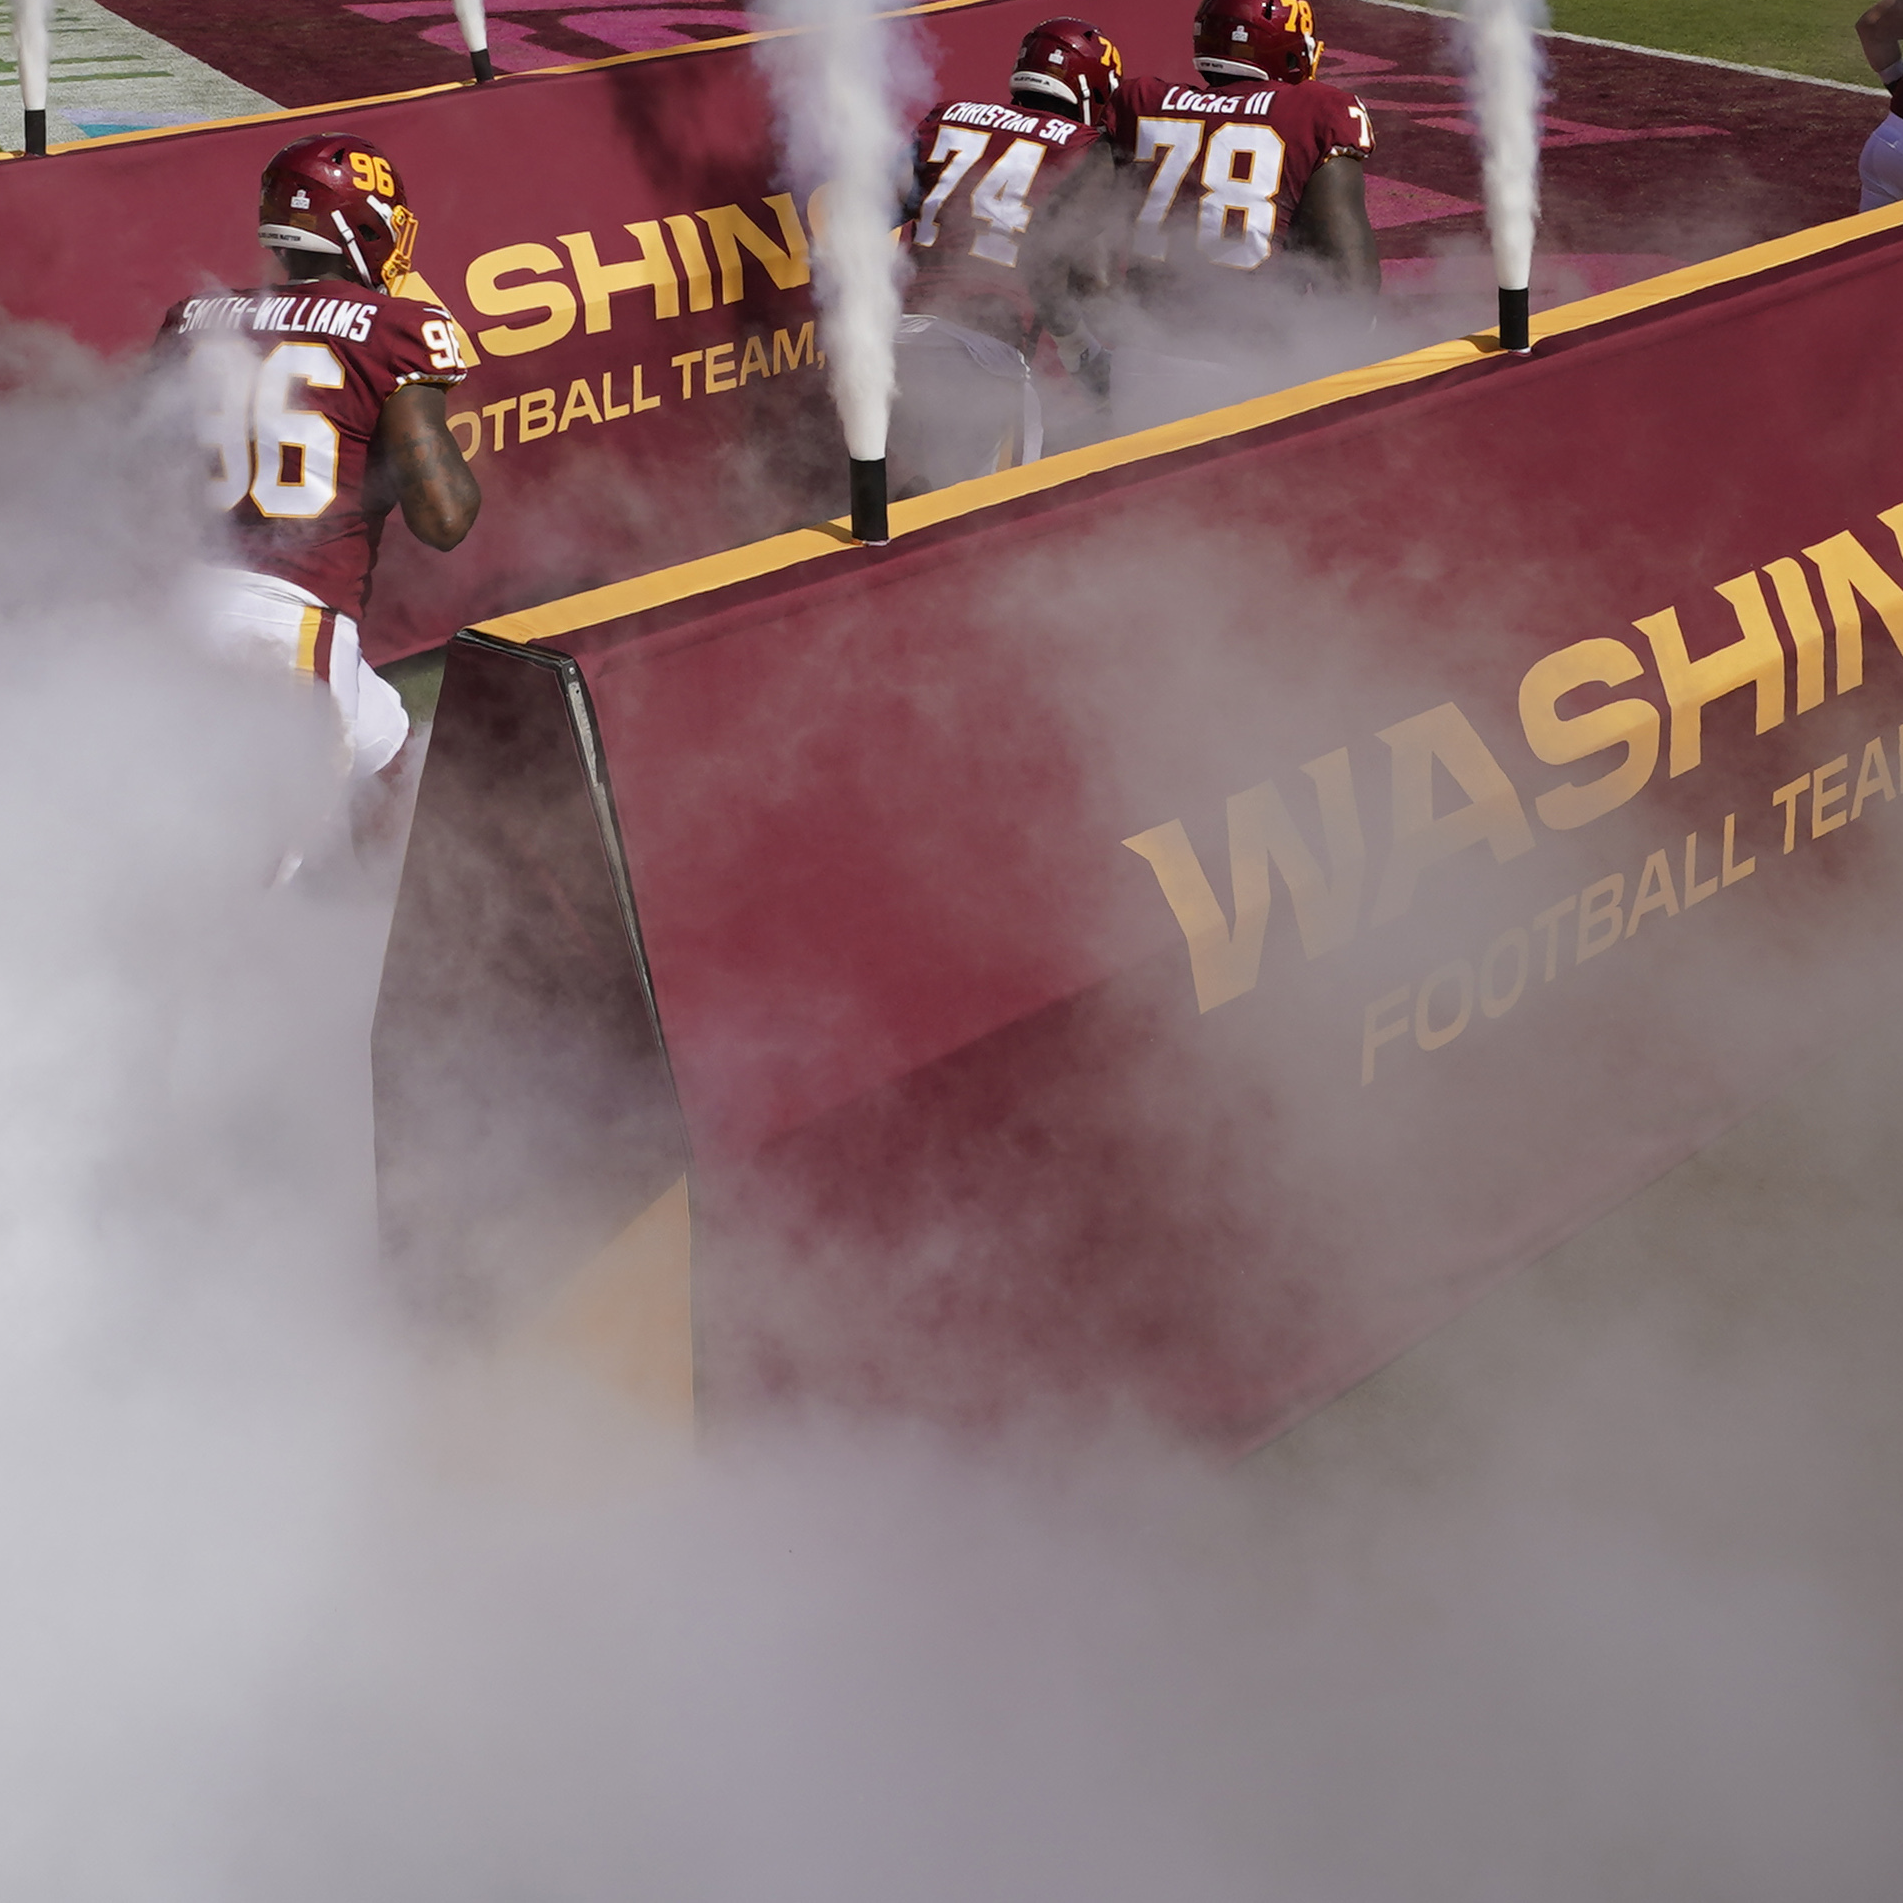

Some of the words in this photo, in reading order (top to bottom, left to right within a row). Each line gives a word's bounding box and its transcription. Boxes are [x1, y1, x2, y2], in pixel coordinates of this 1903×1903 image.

[1161, 84, 1244, 115] LUCAS
[1243, 89, 1277, 115] III
[1039, 118, 1078, 146] SR
[348, 151, 396, 198] 96
[913, 124, 1048, 269] 74
[1133, 116, 1287, 272] 78
[178, 296, 378, 343] SMITH-WILLIAMS
[671, 319, 825, 401] TEAM,
[1358, 813, 1756, 1088] FOOTBALL
